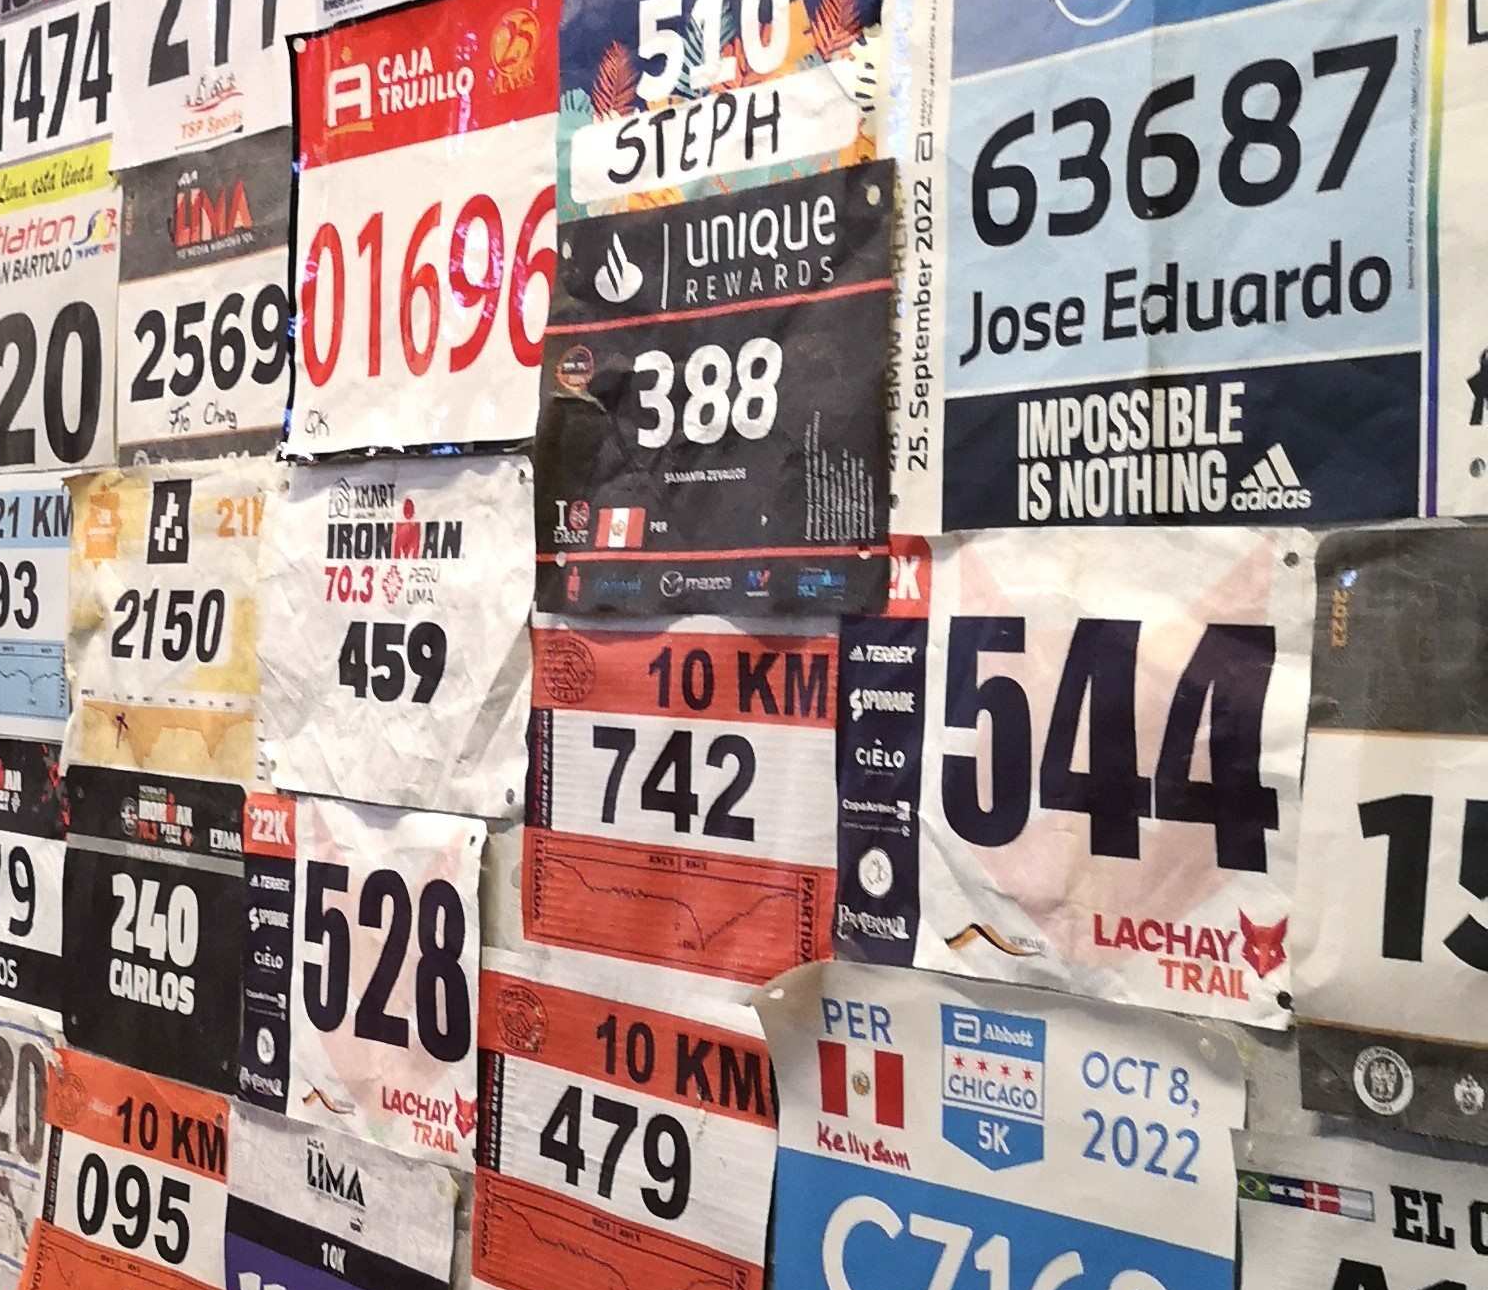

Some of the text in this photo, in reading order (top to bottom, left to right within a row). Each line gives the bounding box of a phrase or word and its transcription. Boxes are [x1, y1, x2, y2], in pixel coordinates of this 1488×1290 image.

[377, 45, 434, 82] CAJA
[377, 66, 475, 114] TRUJILLO
[607, 90, 781, 185] STEPH
[971, 34, 1399, 247] 63687
[914, 175, 932, 252] 2022
[12, 247, 72, 284] BARTOLO
[301, 184, 558, 389] 01696
[684, 256, 836, 304] REWARDS
[959, 239, 1393, 367] Jose Eduardo
[131, 283, 289, 403] 2569
[910, 269, 933, 419] September
[632, 337, 783, 450] 388
[1018, 381, 1246, 460] IMPOSSIBLE
[32, 495, 73, 539] KM
[1018, 450, 1228, 521] IS NOTHING
[1231, 488, 1313, 512] adidas
[326, 498, 463, 560] IRONMAN
[323, 565, 374, 604] 70.3
[405, 588, 436, 605] LIMA
[111, 587, 226, 663] 2150
[338, 621, 448, 704] 459
[648, 646, 830, 720] 10 KM
[941, 616, 1280, 874] 544
[592, 724, 757, 843] 742
[250, 807, 290, 846] 22K
[111, 872, 200, 968] 240
[1093, 913, 1238, 962] LACHAY
[109, 959, 195, 1016] CARLOS
[303, 860, 472, 1064] 528
[1157, 957, 1250, 1002] TRAIL
[822, 997, 893, 1045] PER
[983, 1023, 1034, 1048] Abbott
[595, 1013, 777, 1117] 10 KM
[948, 1073, 1038, 1111] CHICAGO
[1081, 1050, 1201, 1117] OCT 8,
[116, 1096, 227, 1177] 10 KM
[381, 1086, 453, 1125] LACHAY
[412, 1119, 459, 1155] TRAIL
[977, 1119, 1011, 1156] 5K
[539, 1084, 691, 1221] 479
[1081, 1108, 1202, 1184] 2022
[75, 1152, 192, 1266] 095
[1390, 1184, 1457, 1249] EL
